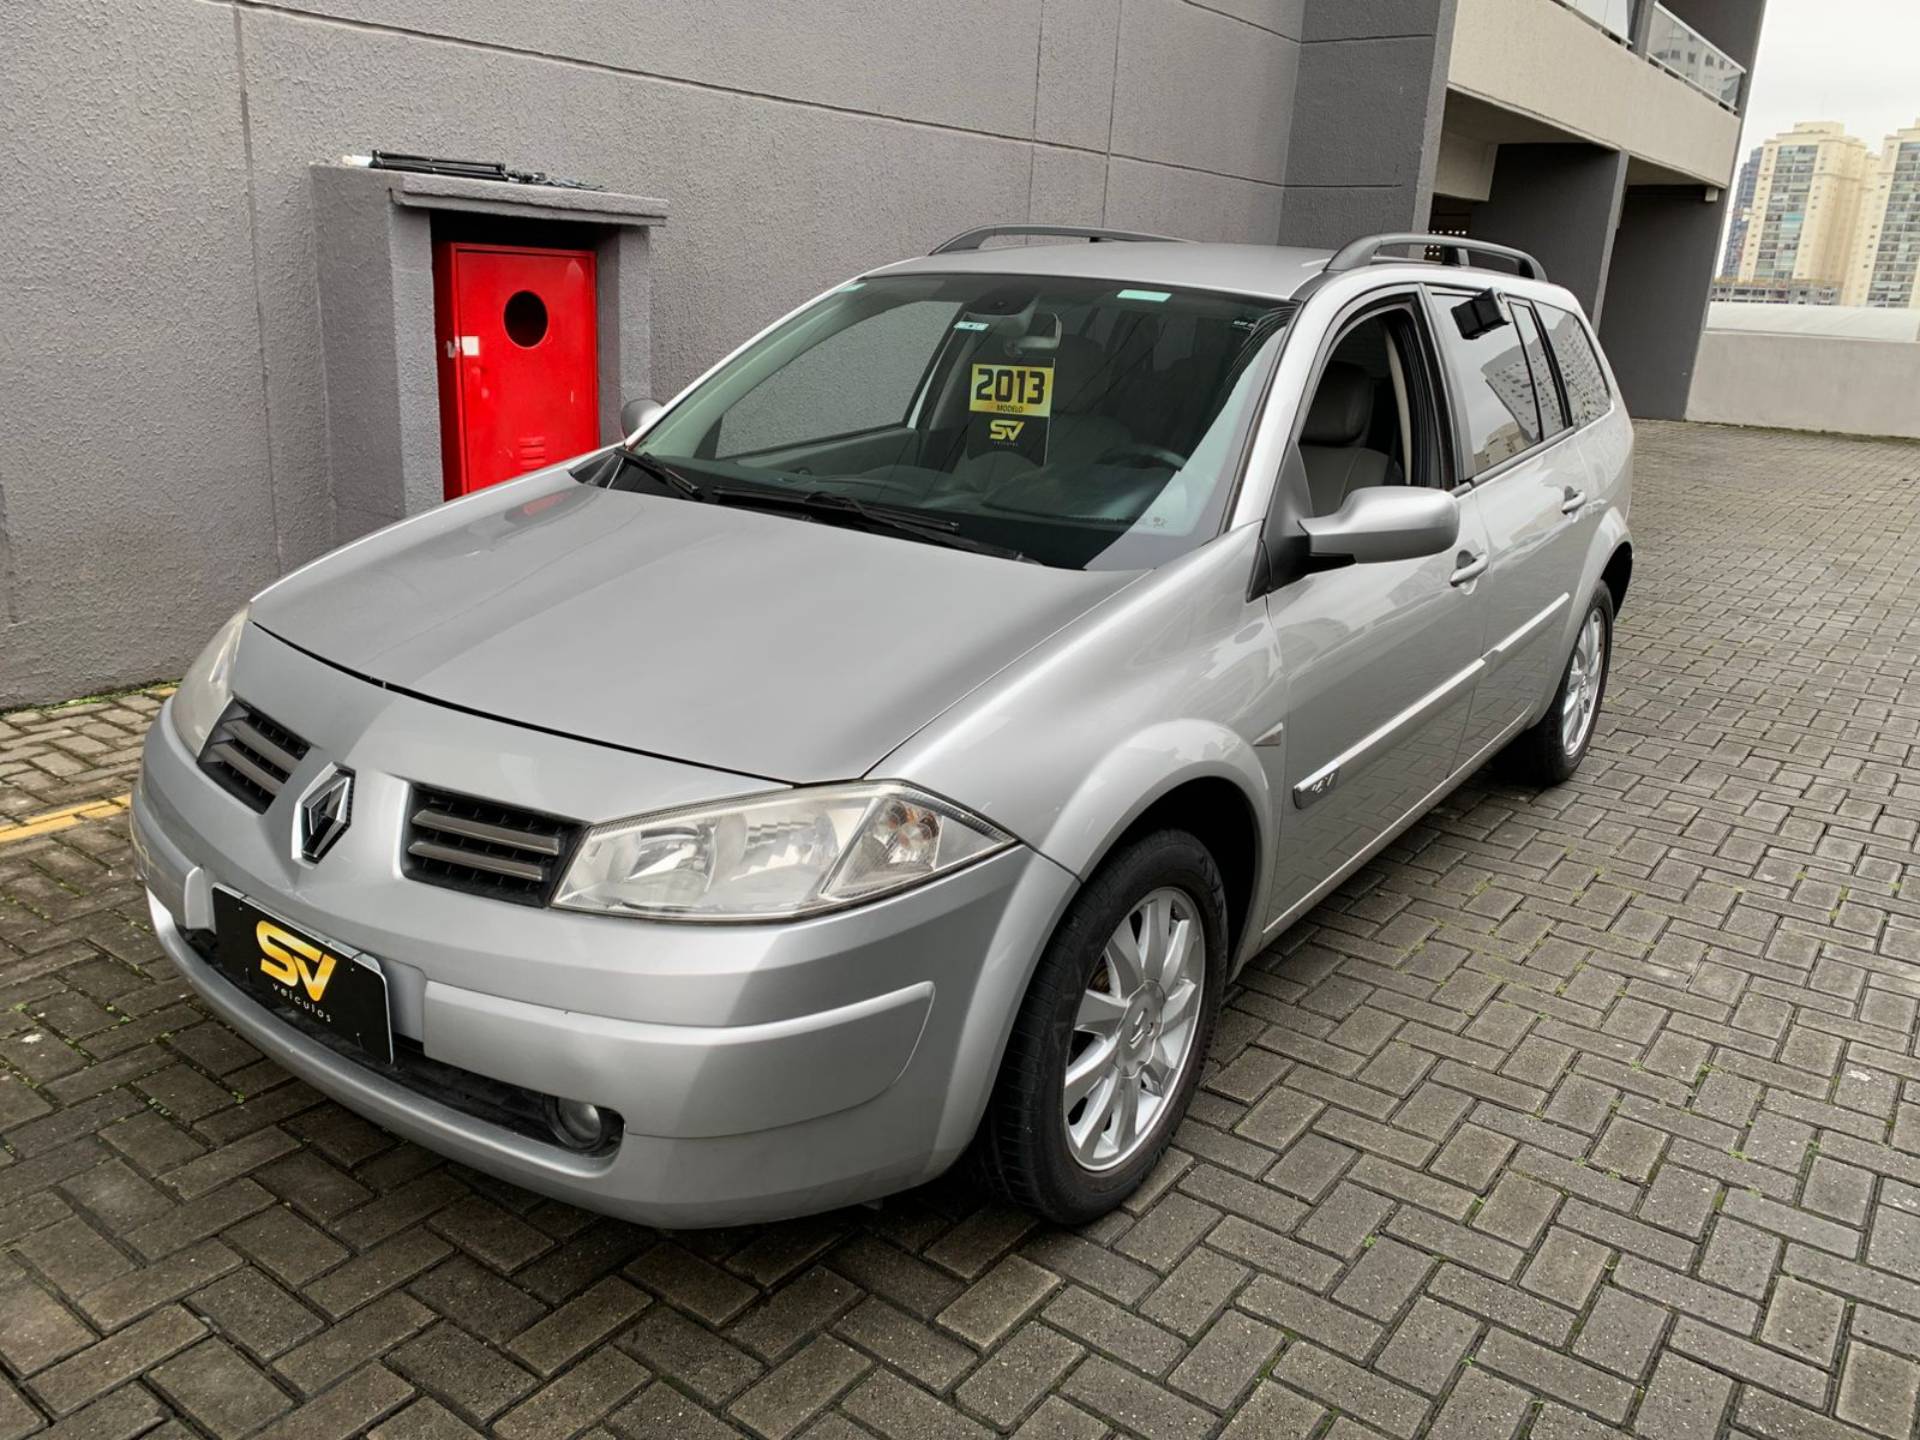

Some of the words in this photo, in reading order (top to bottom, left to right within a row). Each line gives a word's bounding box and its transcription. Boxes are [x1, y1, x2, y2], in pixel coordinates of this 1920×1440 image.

[976, 367, 1045, 405] 2013
[996, 404, 1024, 414] MODELO
[990, 419, 1025, 441] SV
[256, 920, 337, 1002] SV
